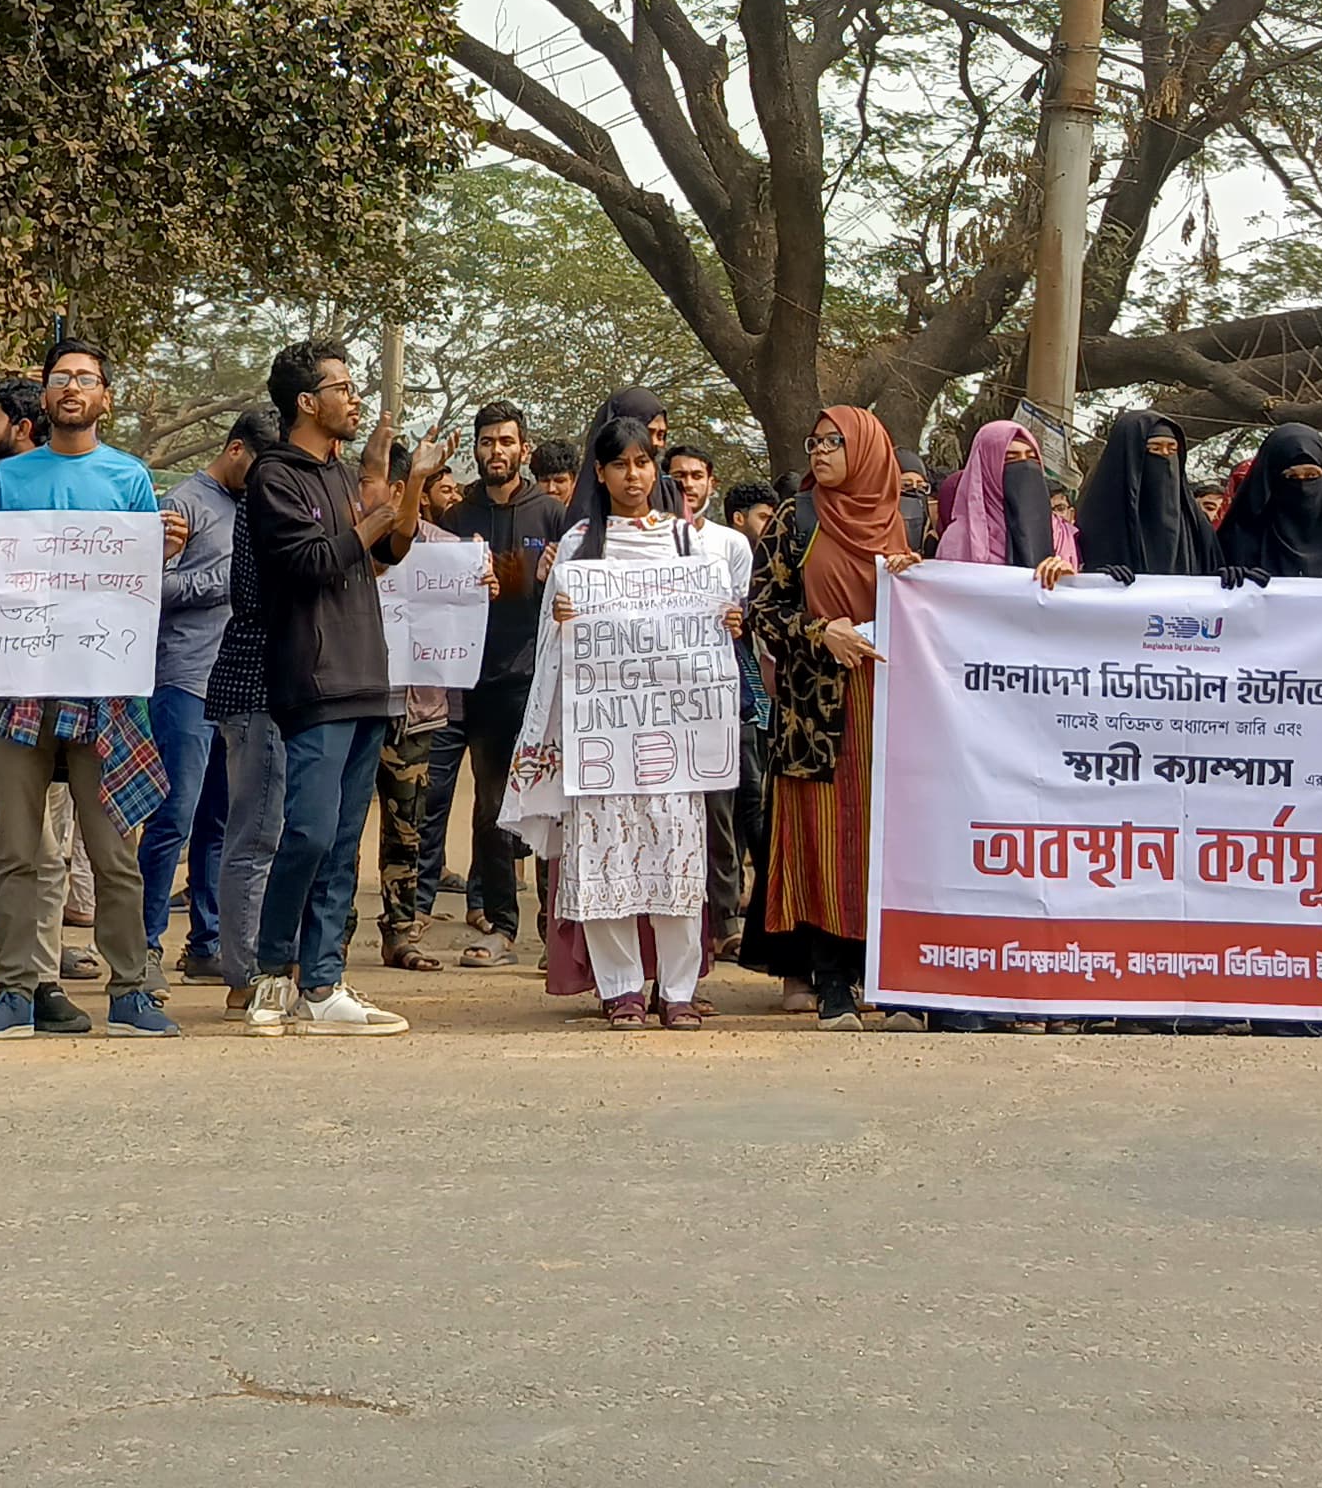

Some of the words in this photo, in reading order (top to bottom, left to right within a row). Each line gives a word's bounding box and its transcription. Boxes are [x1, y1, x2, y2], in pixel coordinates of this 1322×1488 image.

[575, 651, 737, 695] DIGITAL
[965, 662, 1090, 697] বাংলাদেশ
[1099, 662, 1228, 703] ডিজিটাল
[573, 683, 737, 733] UNIVERSITY
[1056, 713, 1098, 731] নামেই
[1236, 717, 1266, 737] জারি
[1274, 722, 1302, 737] এবং
[1063, 741, 1140, 786] স্থায়ী
[1153, 754, 1293, 787] ক্যাম্পাস
[970, 820, 1178, 889] অবস্থান
[919, 943, 994, 971] সাধারণ
[1128, 952, 1219, 979] বাংলাদেশ
[1224, 946, 1311, 980] ডিজিটাল
